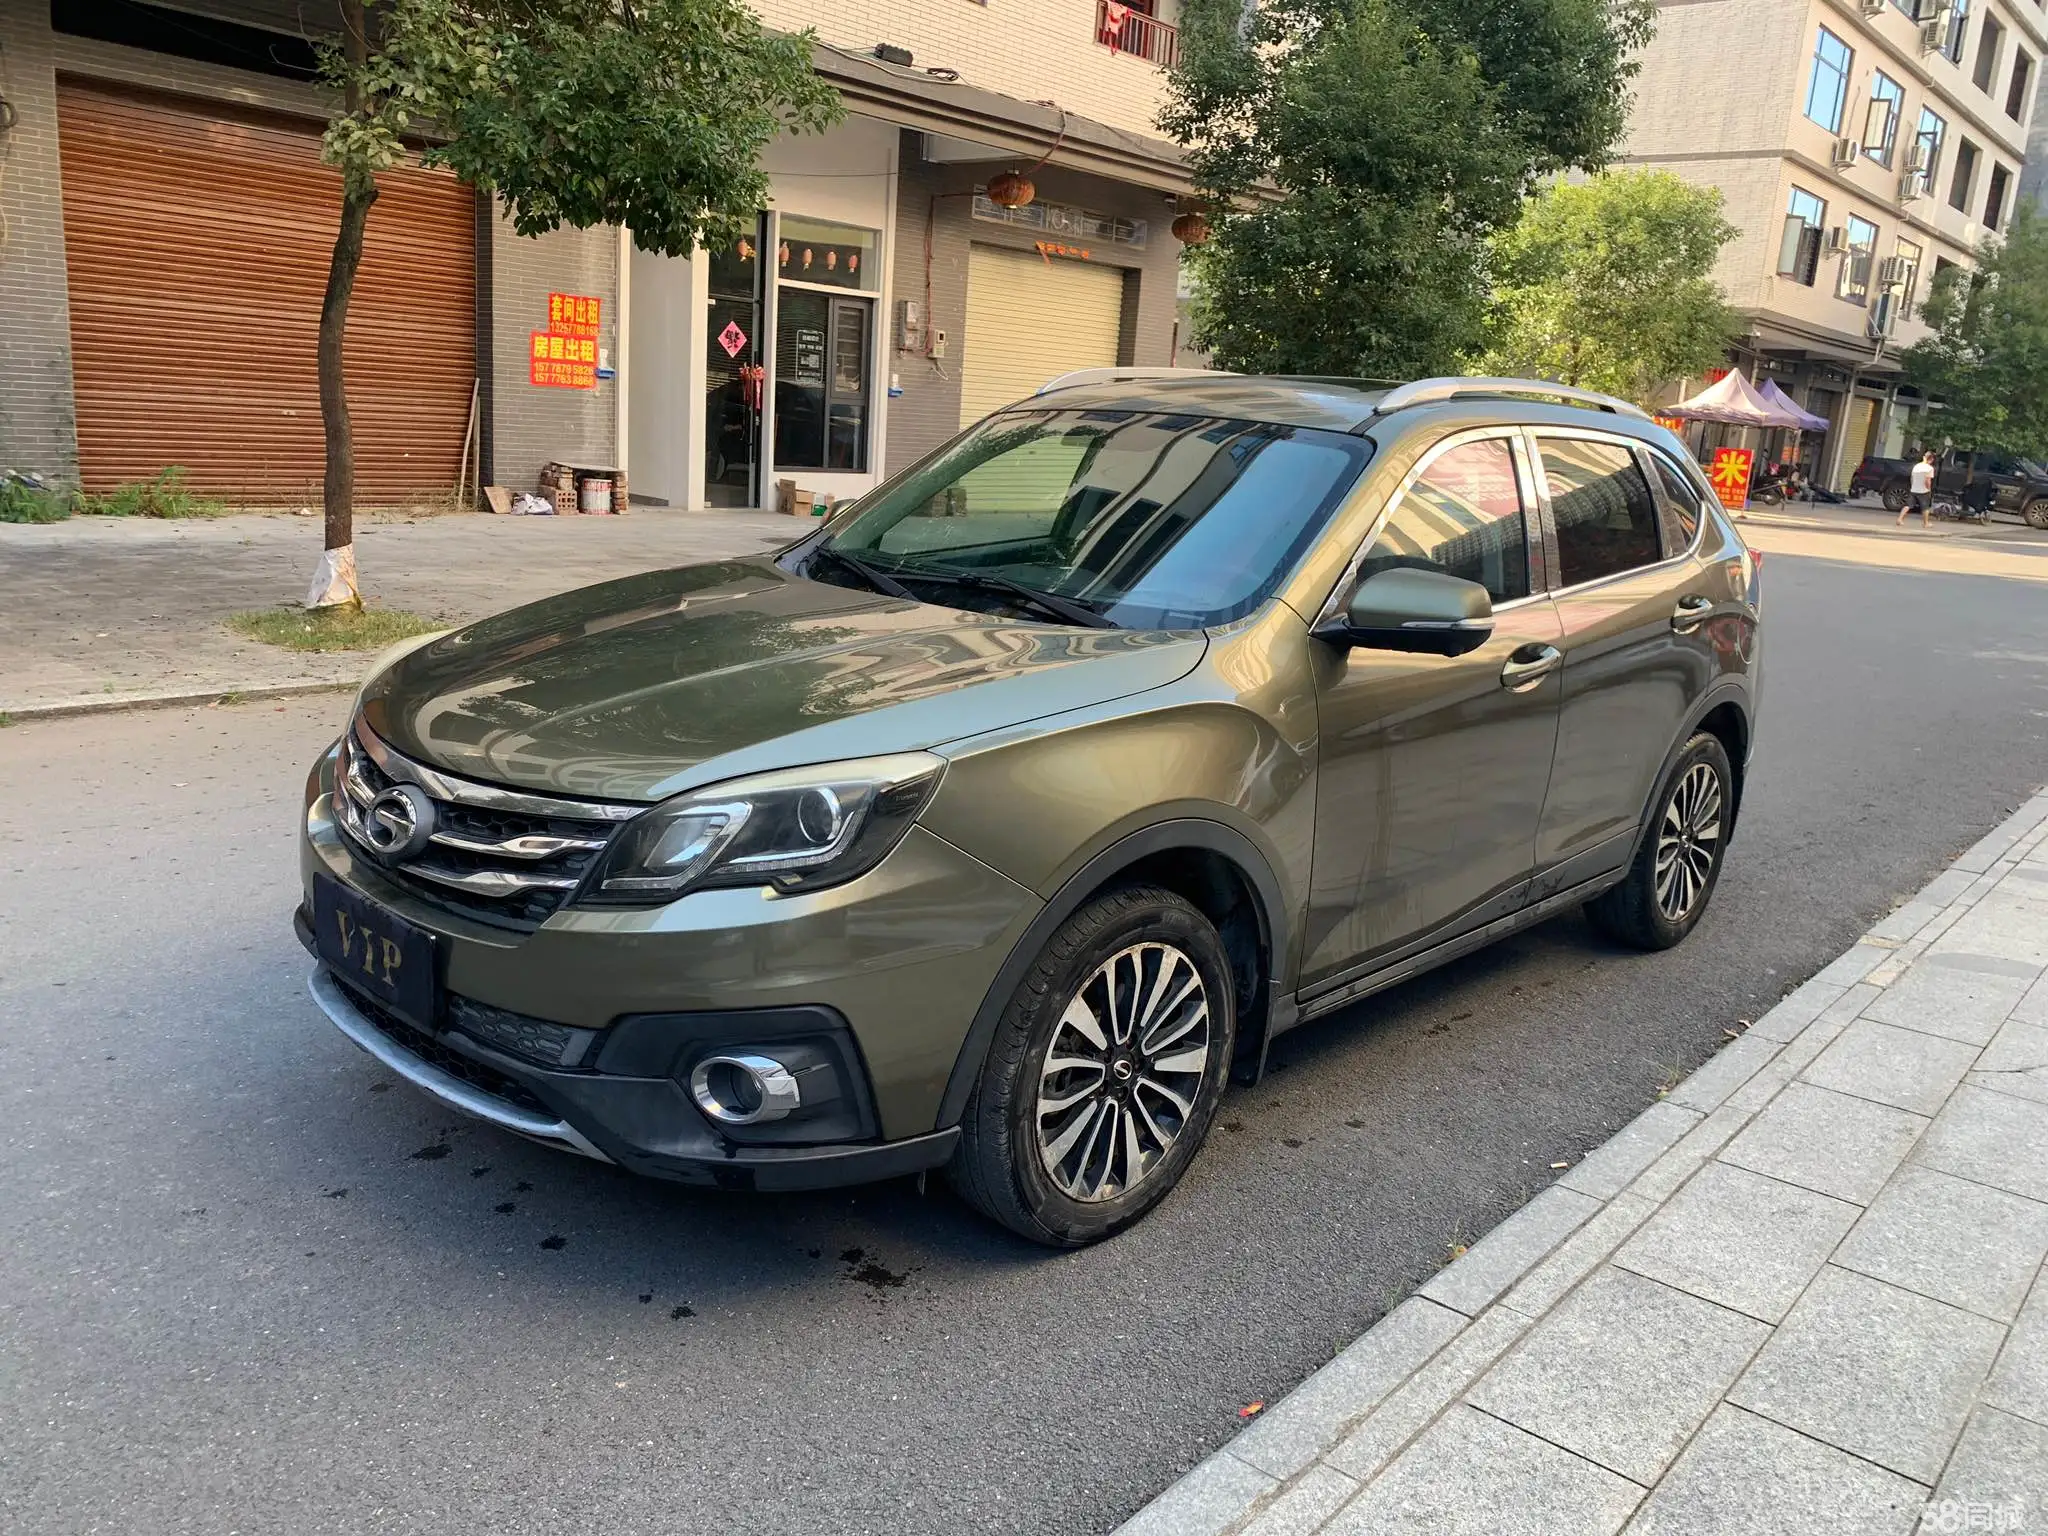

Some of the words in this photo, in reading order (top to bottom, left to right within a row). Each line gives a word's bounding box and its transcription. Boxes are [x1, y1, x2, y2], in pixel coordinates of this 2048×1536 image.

[551, 295, 599, 325] 套间出租
[534, 336, 594, 362] 房屋出租
[1713, 451, 1749, 487] 米
[336, 909, 402, 988] VIP
